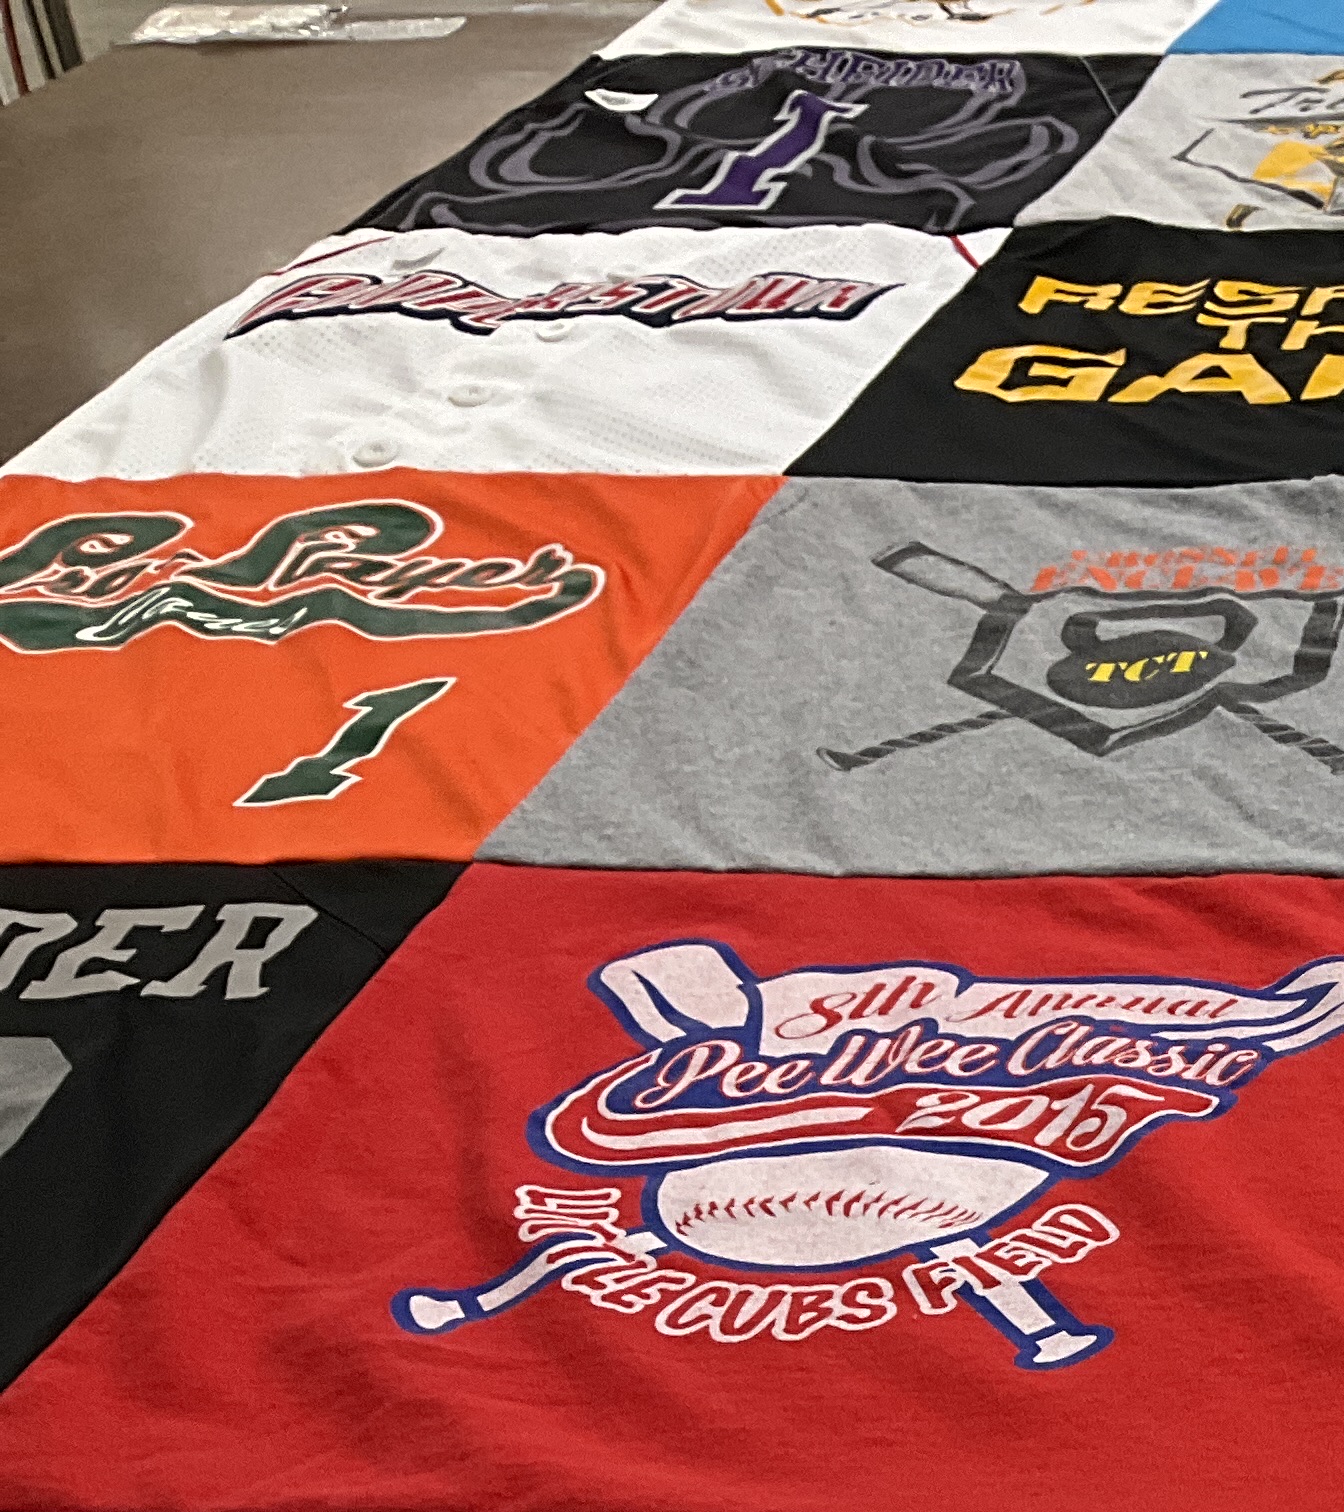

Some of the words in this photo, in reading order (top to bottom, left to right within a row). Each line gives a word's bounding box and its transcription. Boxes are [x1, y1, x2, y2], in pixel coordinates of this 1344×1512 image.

[653, 89, 869, 210] 1
[1084, 648, 1209, 683] TCT
[233, 675, 457, 806] 1
[774, 974, 944, 1041] 8th
[948, 984, 1241, 1024] Annual
[634, 1040, 814, 1110] Pee
[818, 1025, 1001, 1088] Wee
[1005, 1017, 1257, 1090] Classic
[895, 1083, 1166, 1153] 2015
[655, 1277, 897, 1344] CUBS
[904, 1203, 1121, 1315] FIELD
